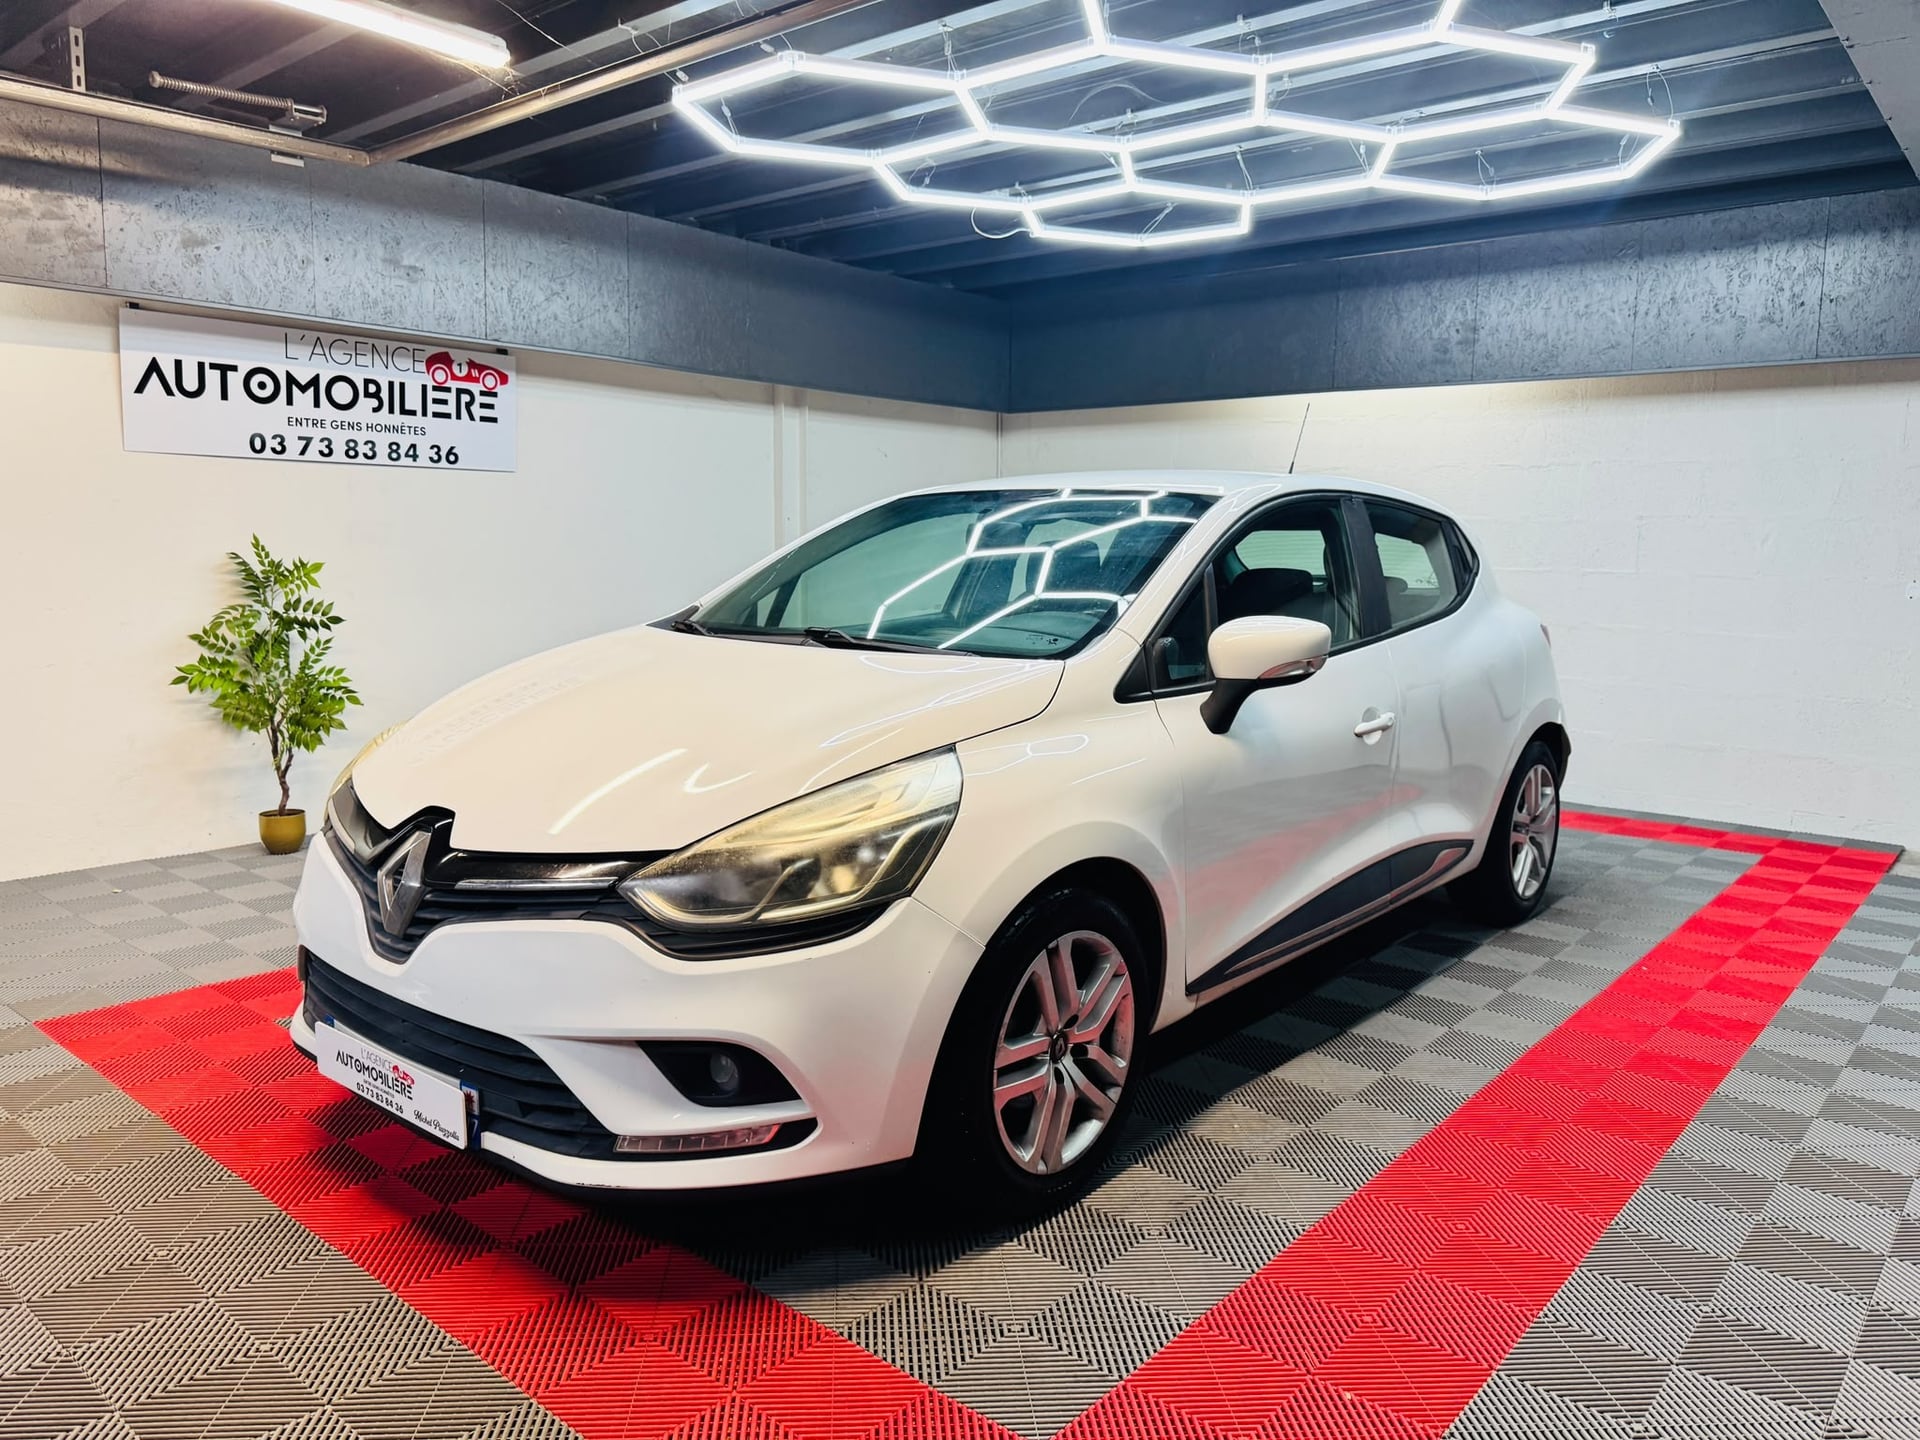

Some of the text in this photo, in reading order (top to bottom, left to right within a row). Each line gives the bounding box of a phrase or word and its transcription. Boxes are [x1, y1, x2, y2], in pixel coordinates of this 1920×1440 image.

[284, 331, 426, 374] L'AGENCE
[133, 356, 499, 424] AUTOMOBILIERE
[287, 416, 427, 436] ENTRE GENS HONNÊTES
[249, 432, 460, 465] 03 73 83 84 36
